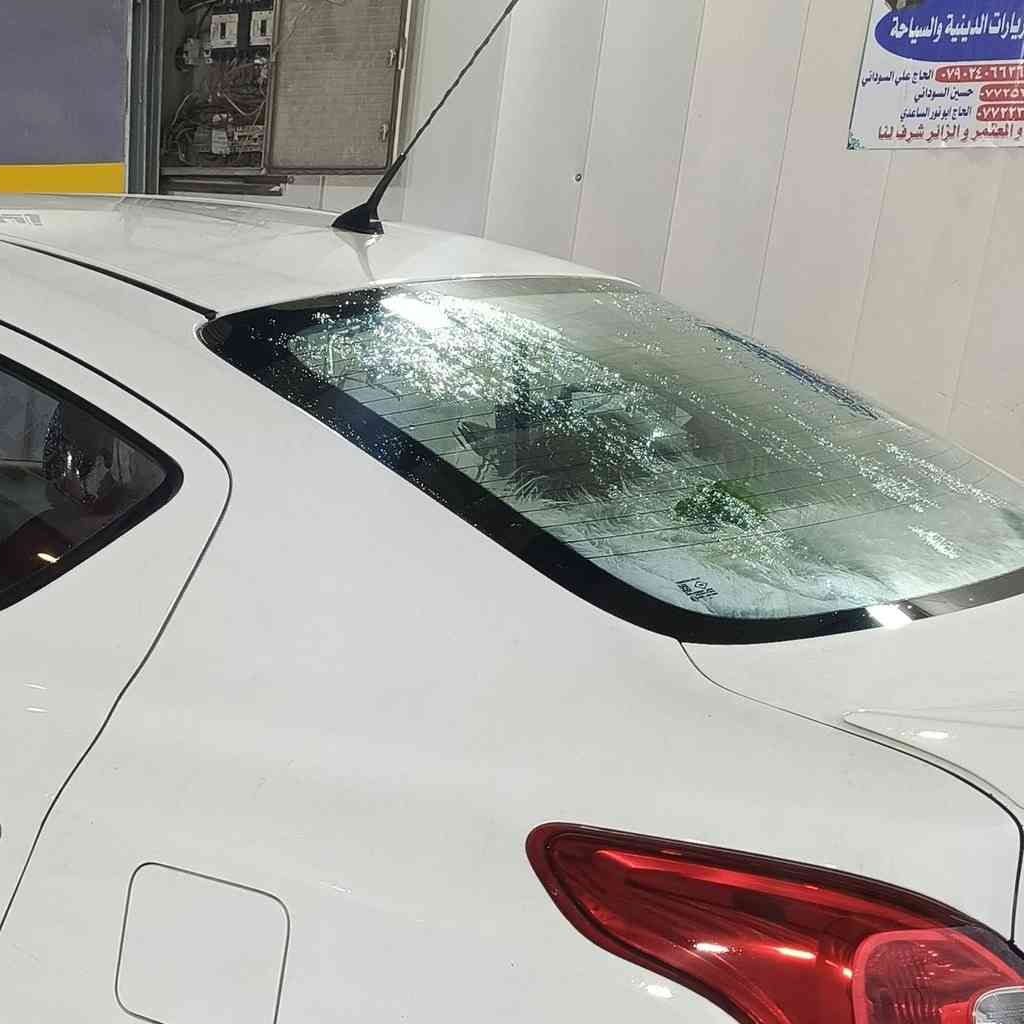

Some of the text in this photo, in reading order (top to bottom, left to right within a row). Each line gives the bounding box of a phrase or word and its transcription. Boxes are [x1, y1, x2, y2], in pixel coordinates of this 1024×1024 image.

[890, 15, 942, 44] والسياحة
[945, 13, 988, 43] الدينية
[895, 69, 911, 86] علي
[912, 69, 934, 84] الحاج
[914, 86, 949, 103] السوداني
[950, 87, 973, 101] حسين
